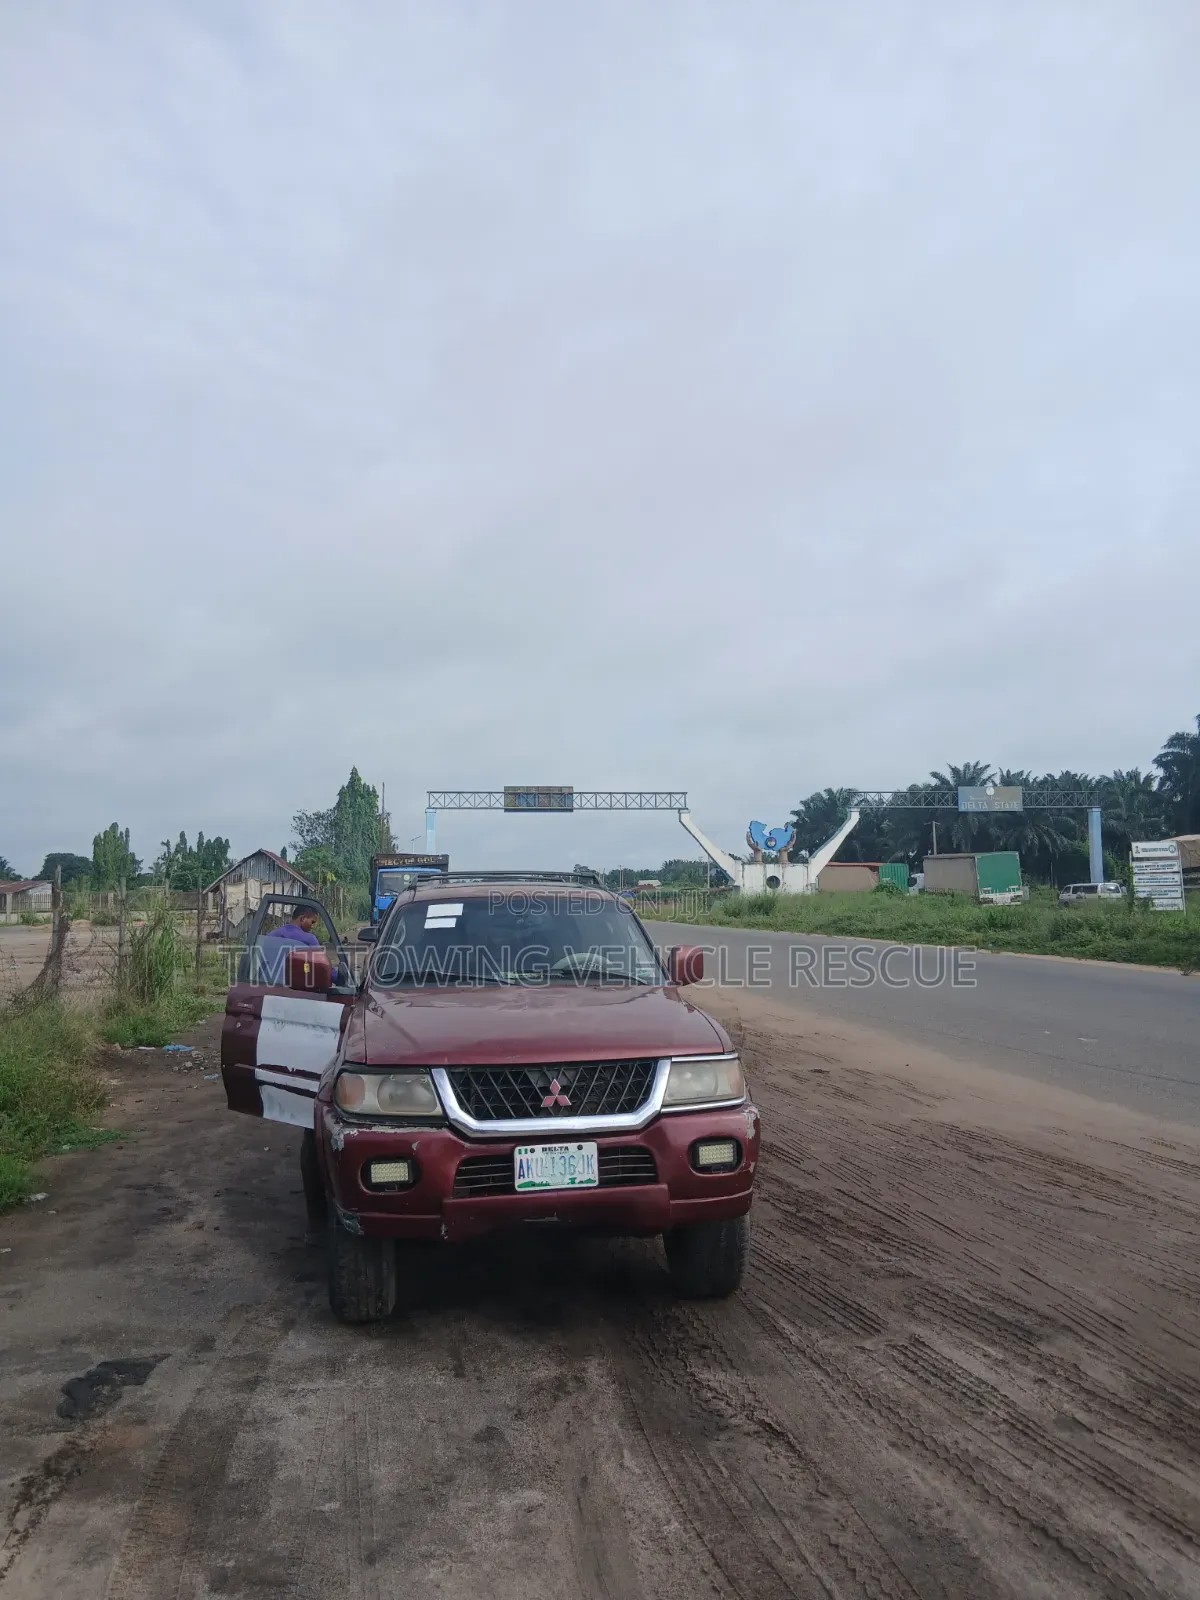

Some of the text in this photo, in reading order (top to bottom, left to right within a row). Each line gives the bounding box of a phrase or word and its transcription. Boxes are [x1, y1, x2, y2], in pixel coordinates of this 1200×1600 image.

[961, 801, 1020, 809] DELTA STATE
[541, 1145, 570, 1153] DELTA
